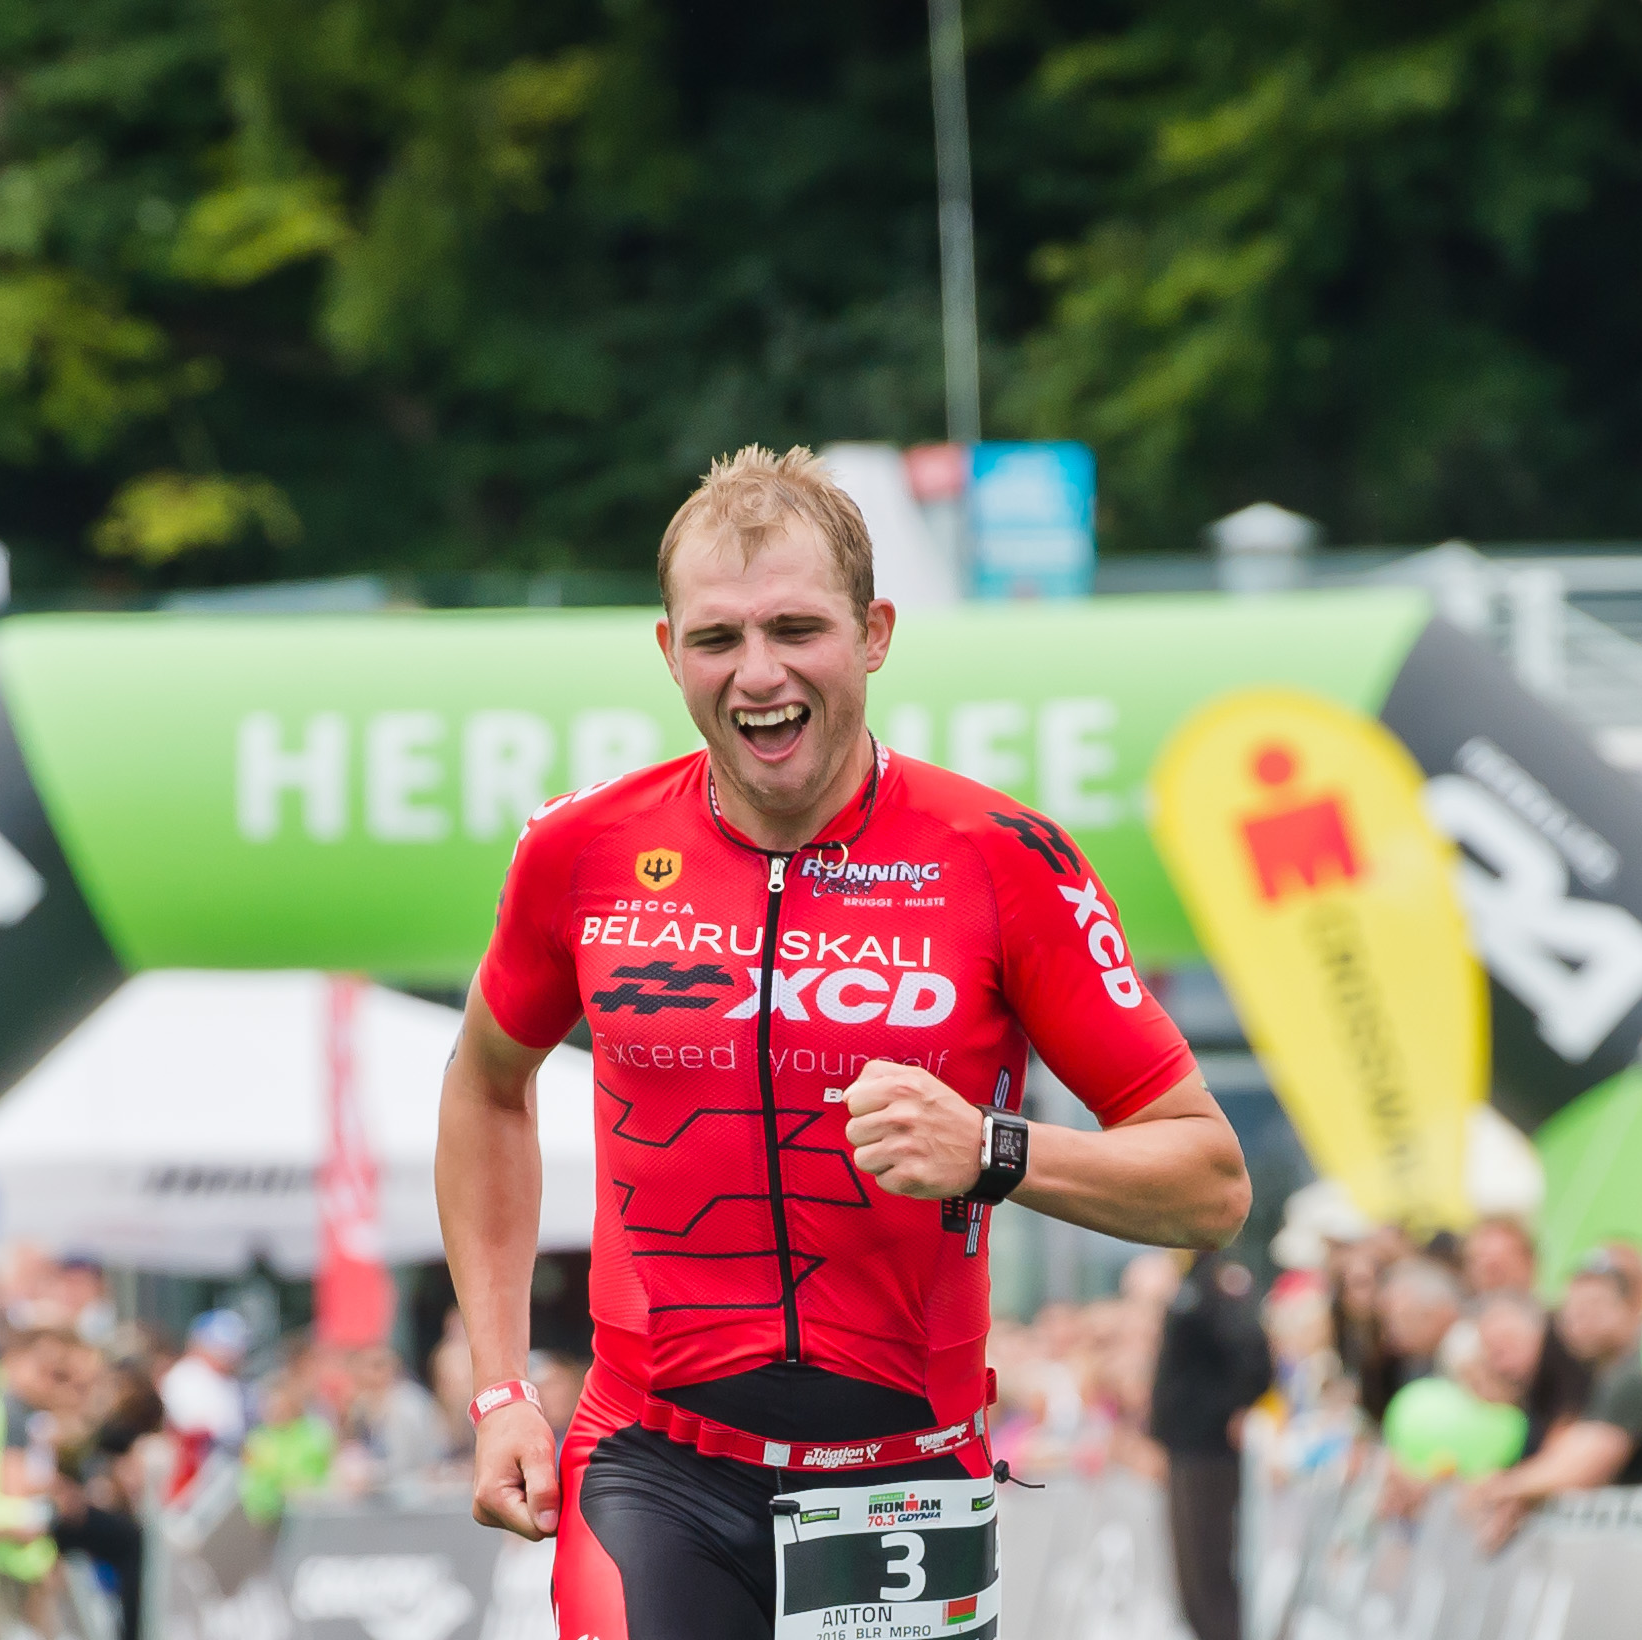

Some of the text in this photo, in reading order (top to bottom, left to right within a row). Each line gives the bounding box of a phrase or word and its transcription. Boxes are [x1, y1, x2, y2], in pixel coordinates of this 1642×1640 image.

[233, 696, 1122, 843] HERBFE
[801, 857, 940, 882] RUNNING
[614, 899, 694, 915] DECCA
[843, 896, 946, 908] BRUGGE HULSTE
[580, 915, 932, 968] BELARUSKALI
[1056, 876, 1143, 1009] XCD
[722, 965, 958, 1028] XCD
[595, 1032, 950, 1078] Exceed yourlf
[812, 1446, 864, 1460] Triatlon
[868, 1495, 942, 1515] IRONMAN
[867, 1511, 942, 1528] 70.3 GDYNIA
[879, 1531, 927, 1602] 3
[822, 1605, 893, 1629] ANTON
[856, 1626, 883, 1640] BLR
[889, 1624, 933, 1638] MPRO
